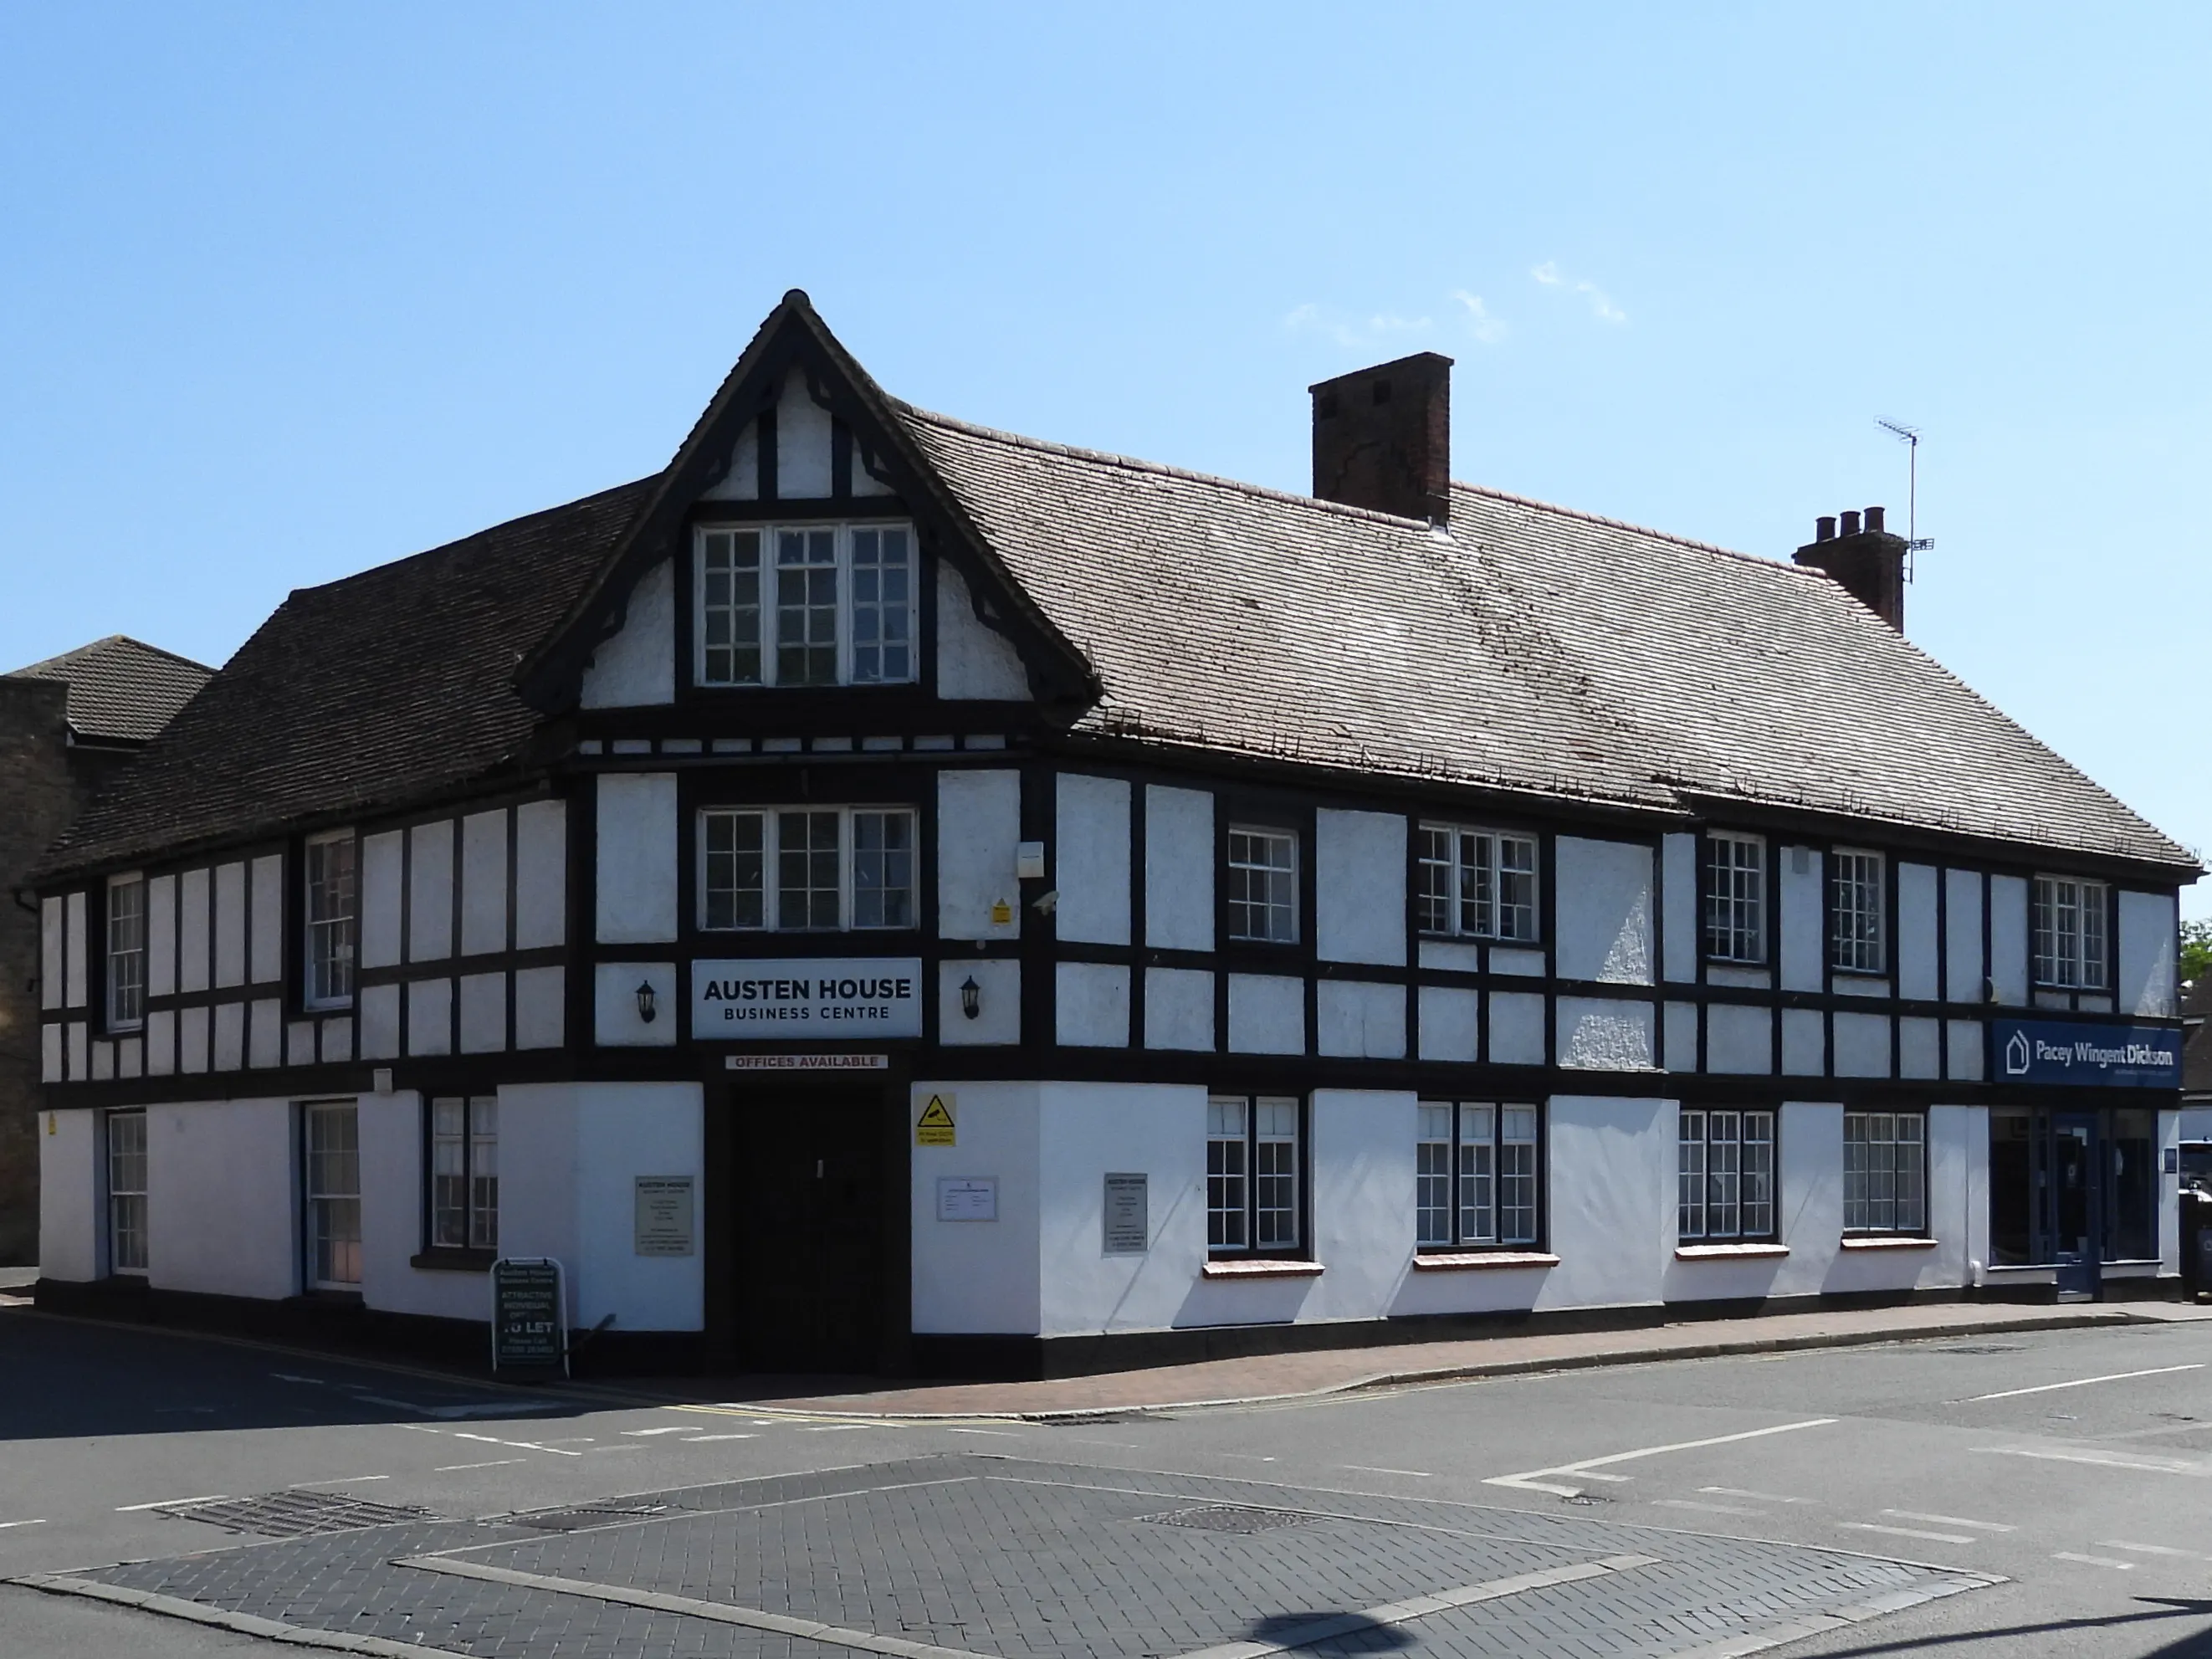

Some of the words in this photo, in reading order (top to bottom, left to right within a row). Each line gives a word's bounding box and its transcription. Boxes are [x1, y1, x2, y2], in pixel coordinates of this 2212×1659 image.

[704, 981, 809, 1001] AUSTEN
[820, 979, 911, 1000] HOUSE
[725, 1007, 809, 1020] BUSINESS
[821, 1006, 889, 1019] CENTRE
[2036, 1040, 2072, 1067] Pacey
[2075, 1042, 2127, 1068] Wingent
[2127, 1044, 2174, 1066] Dickson
[735, 1057, 795, 1068] OFFICES
[799, 1057, 878, 1068] AVAILABLE
[526, 1322, 555, 1333] LET
